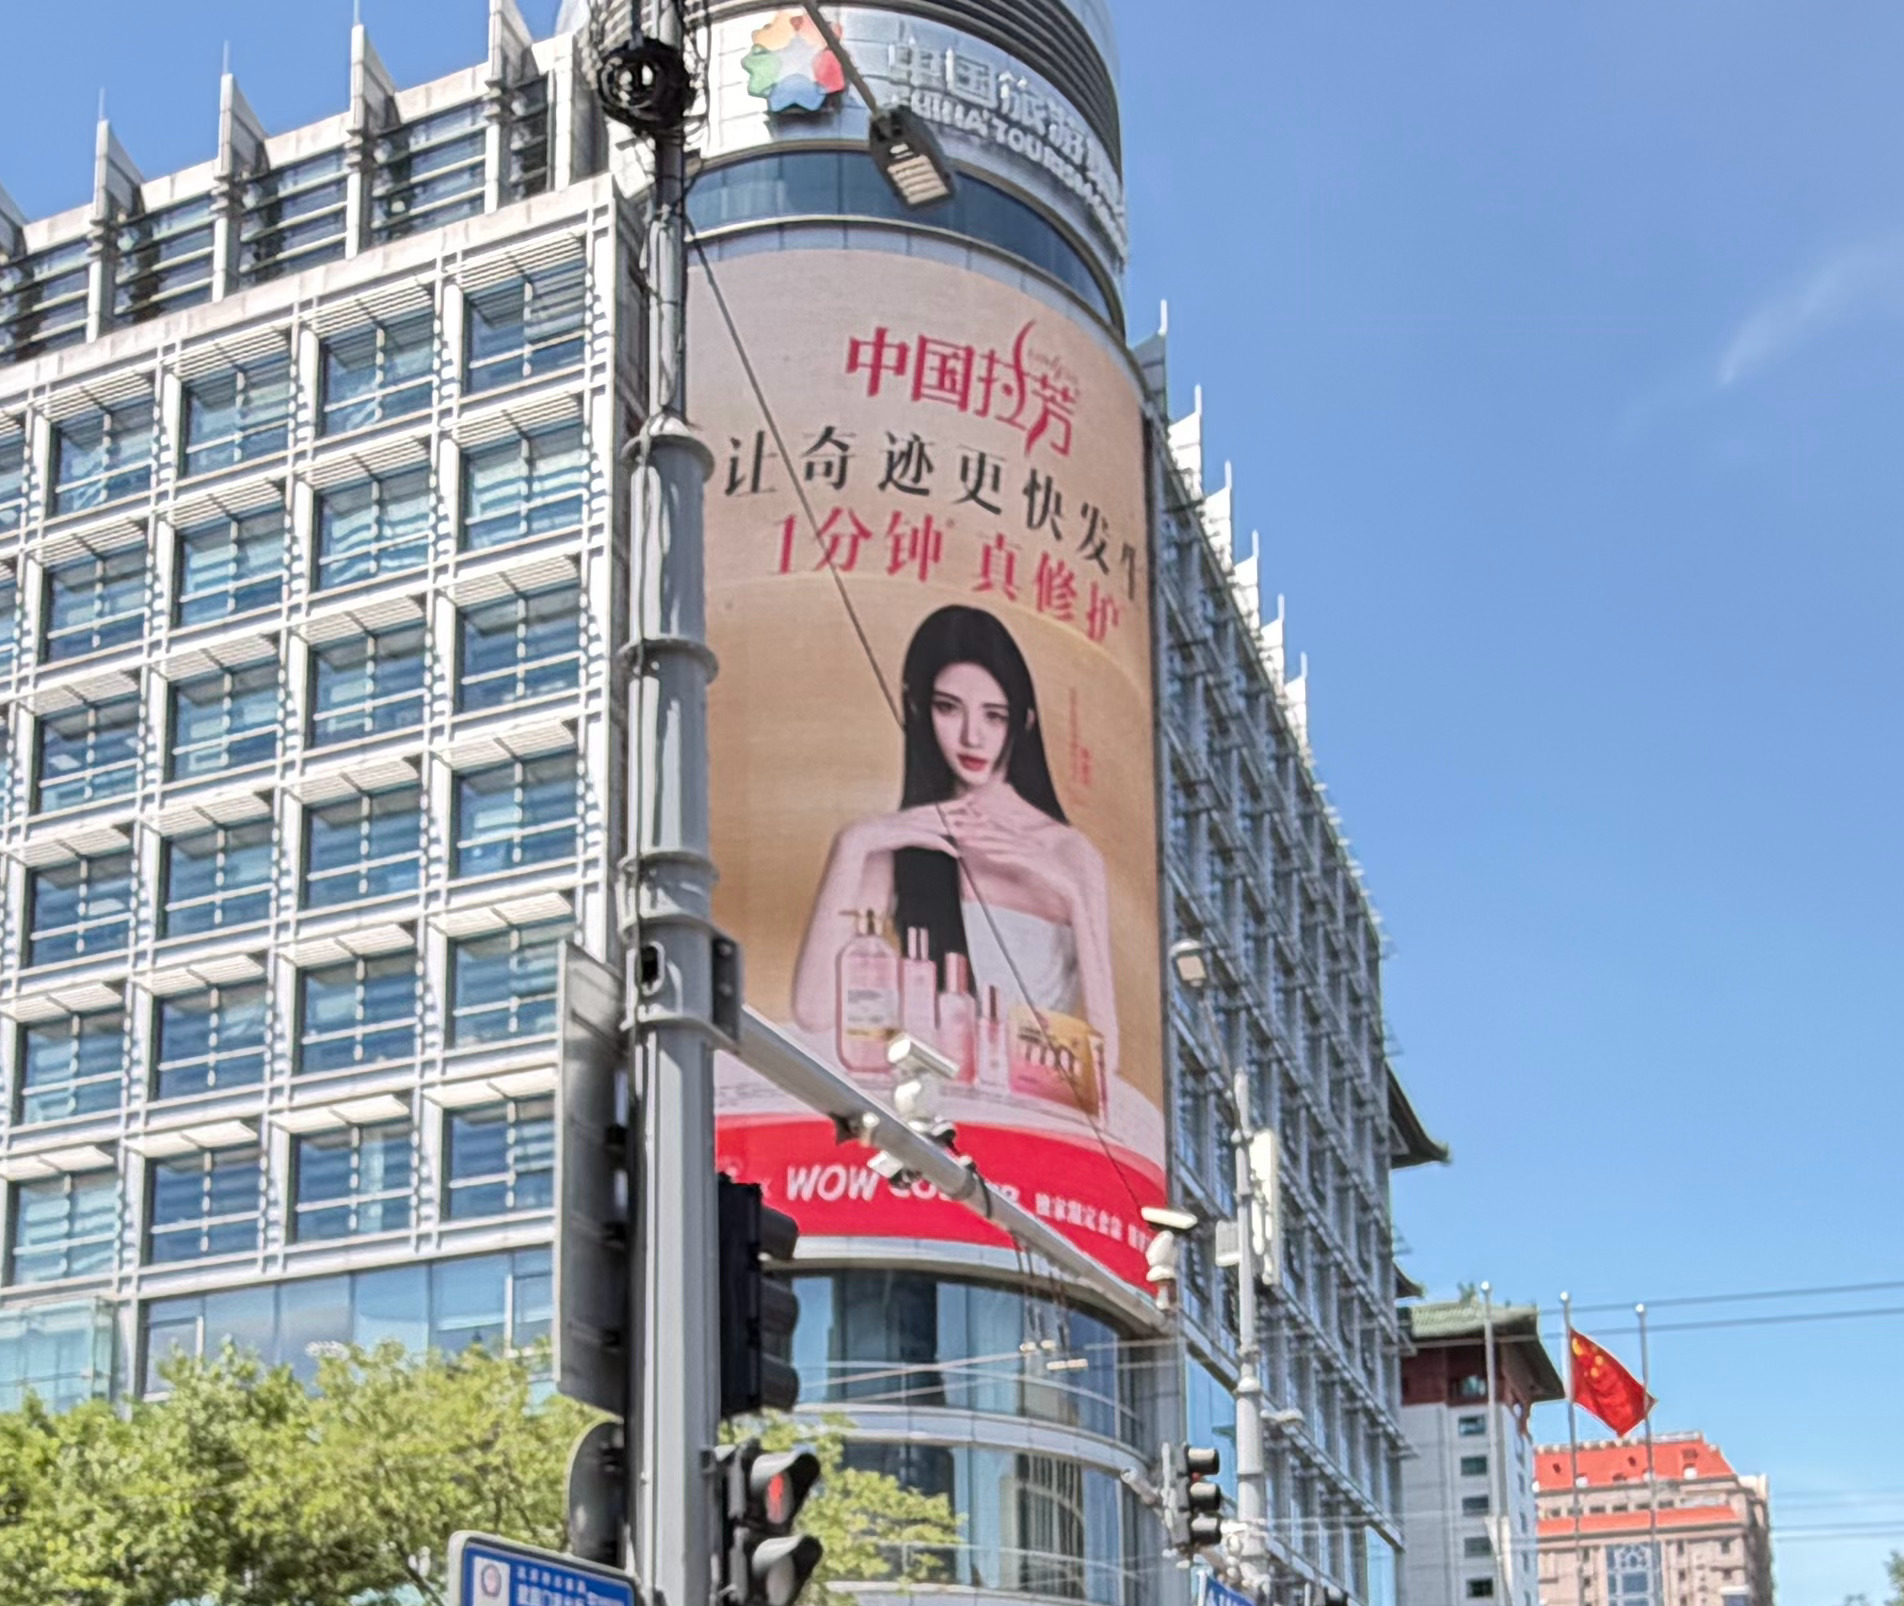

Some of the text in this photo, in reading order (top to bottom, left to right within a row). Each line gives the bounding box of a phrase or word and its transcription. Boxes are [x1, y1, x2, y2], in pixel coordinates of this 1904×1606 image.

[888, 36, 1124, 214] 中国旅游
[891, 92, 989, 138] HINA
[846, 320, 1076, 455] 中国拉芳
[972, 533, 1120, 642] 真修护
[787, 1164, 880, 1201] WOW
